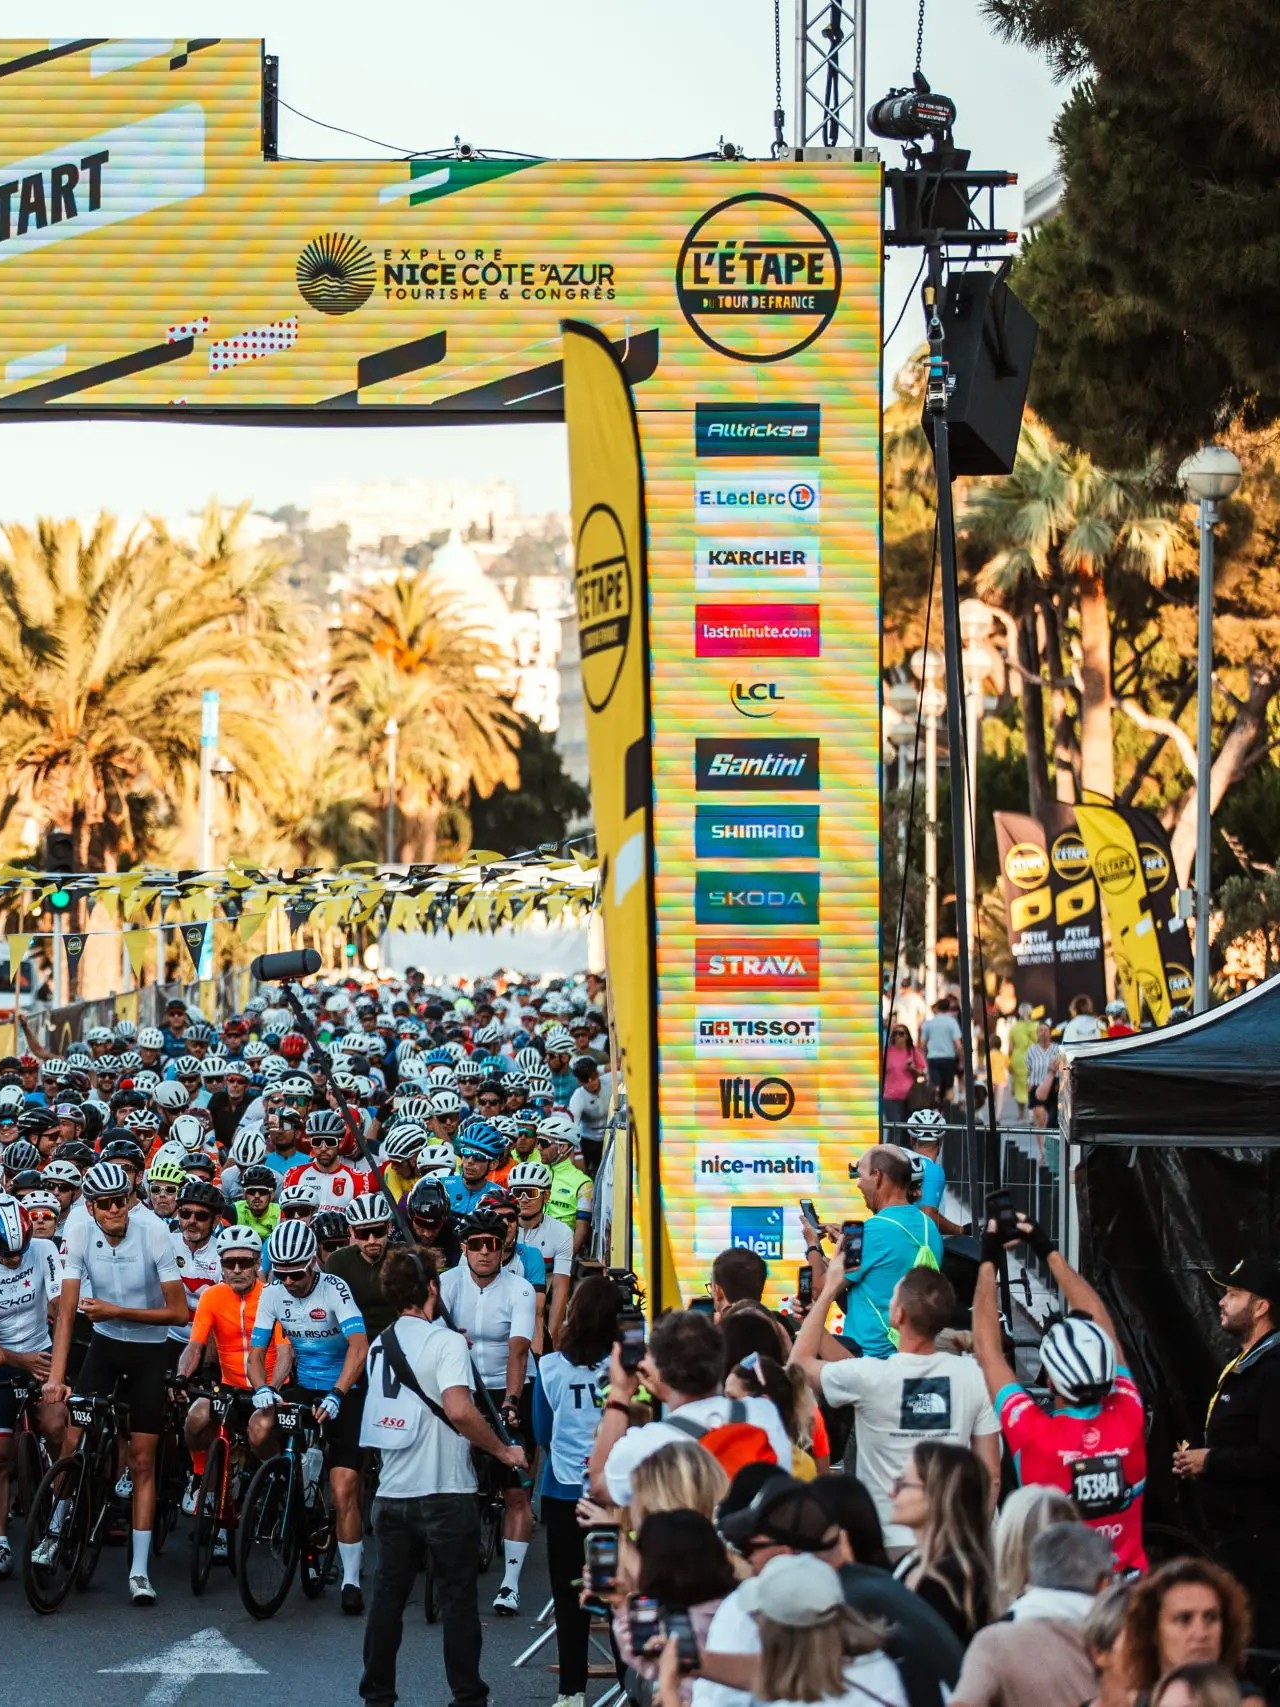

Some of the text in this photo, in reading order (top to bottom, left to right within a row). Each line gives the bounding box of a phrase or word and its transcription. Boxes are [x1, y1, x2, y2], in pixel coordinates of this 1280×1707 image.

[384, 248, 502, 260] EXPLORE
[694, 241, 824, 285] L'ÉTAPE
[384, 263, 456, 286] NICE
[462, 260, 535, 286] CÔTE
[384, 286, 616, 300] TOURISME & CONGRÈS
[718, 295, 749, 309] TOUR
[751, 296, 766, 309] DE
[768, 295, 815, 309] FRANCE
[707, 423, 792, 437] Alltricks
[699, 491, 786, 505] E.Leclerc
[708, 550, 806, 565] KÄRCHER
[703, 624, 812, 639] lastminute.com
[735, 683, 785, 700] LCL
[707, 753, 808, 777] Santini
[711, 824, 805, 839] SHIMANO
[708, 954, 807, 976] STRAVA
[732, 1020, 816, 1036] TISSOT
[719, 1077, 795, 1121] VÉLO
[701, 1155, 814, 1174] nice-matin
[323, 1274, 352, 1305] RISOUL
[304, 1326, 340, 1339] RISOUL
[72, 1409, 92, 1423] 1036
[277, 1413, 297, 1426] 1365
[377, 1416, 406, 1428] ASO
[1074, 1471, 1119, 1501] 15384
